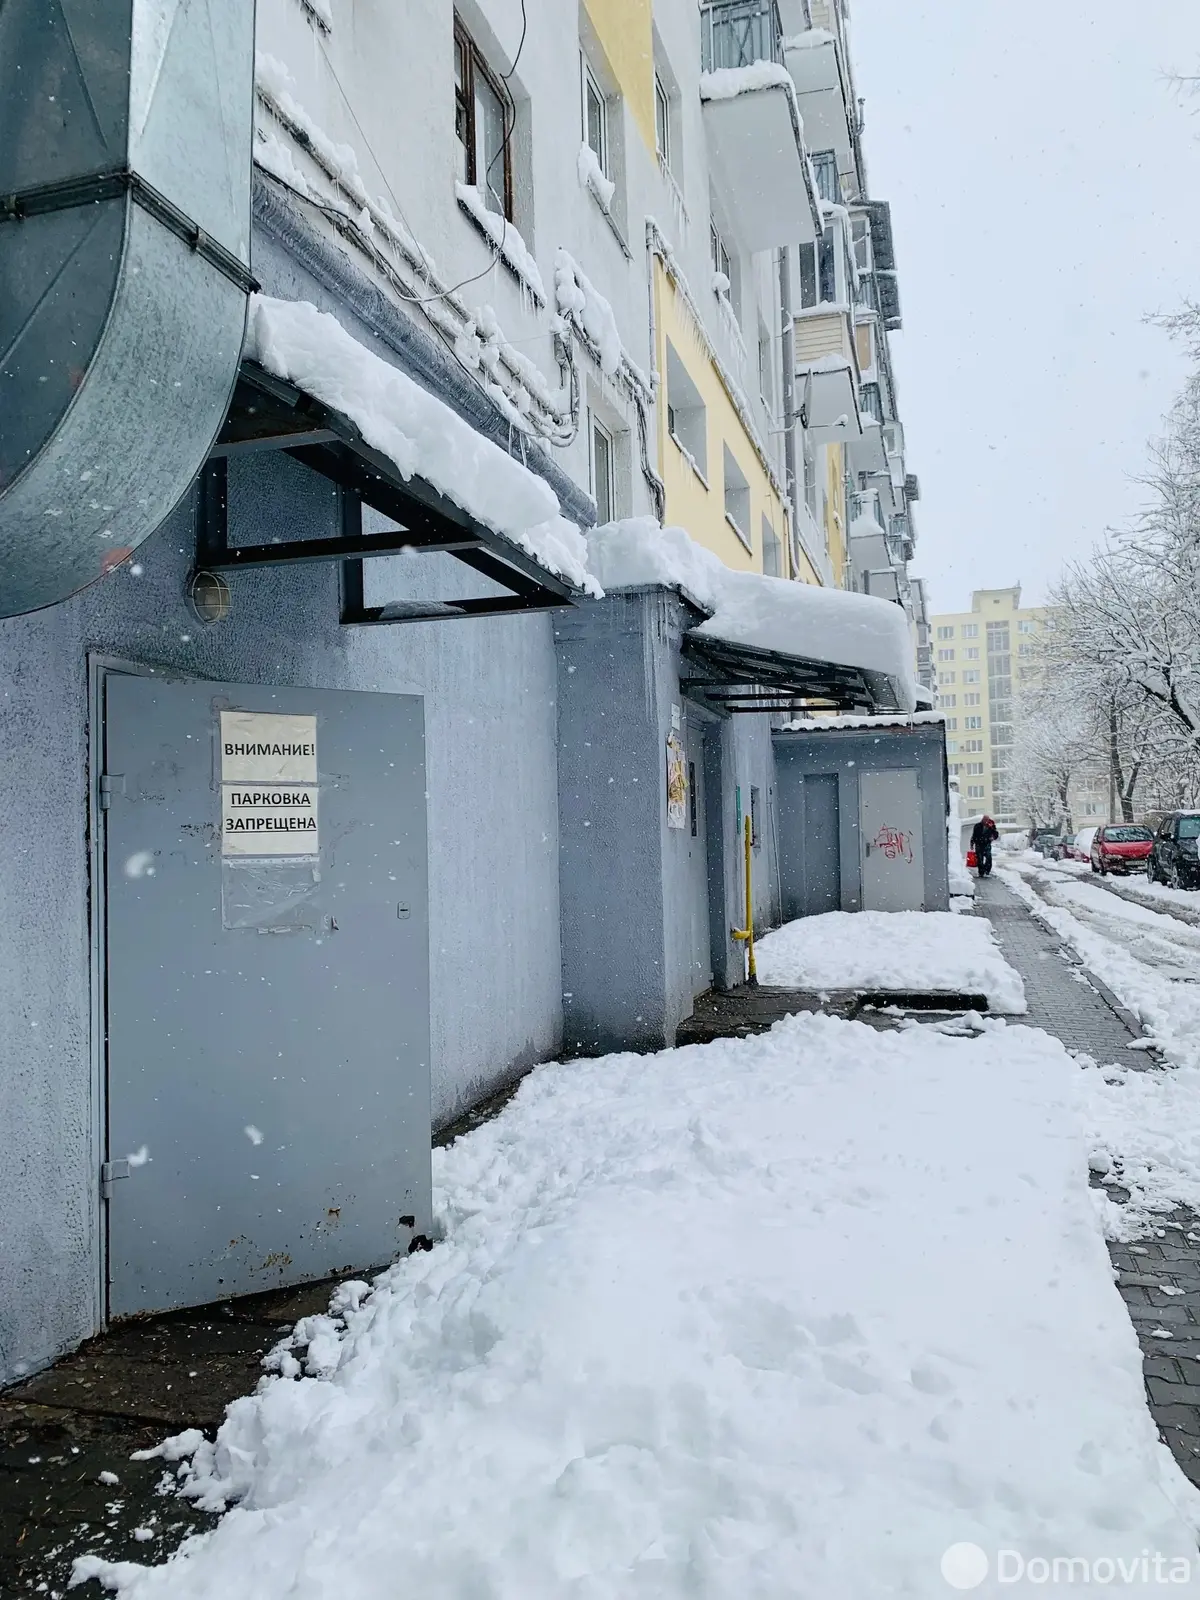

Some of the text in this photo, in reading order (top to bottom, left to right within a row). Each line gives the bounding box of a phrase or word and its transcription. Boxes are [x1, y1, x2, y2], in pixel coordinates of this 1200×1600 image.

[225, 743, 315, 756] ВНИМАНИЕ!
[230, 792, 311, 806] ПАРКОВКА
[225, 816, 317, 832] ЗАПРЕЩЕНА
